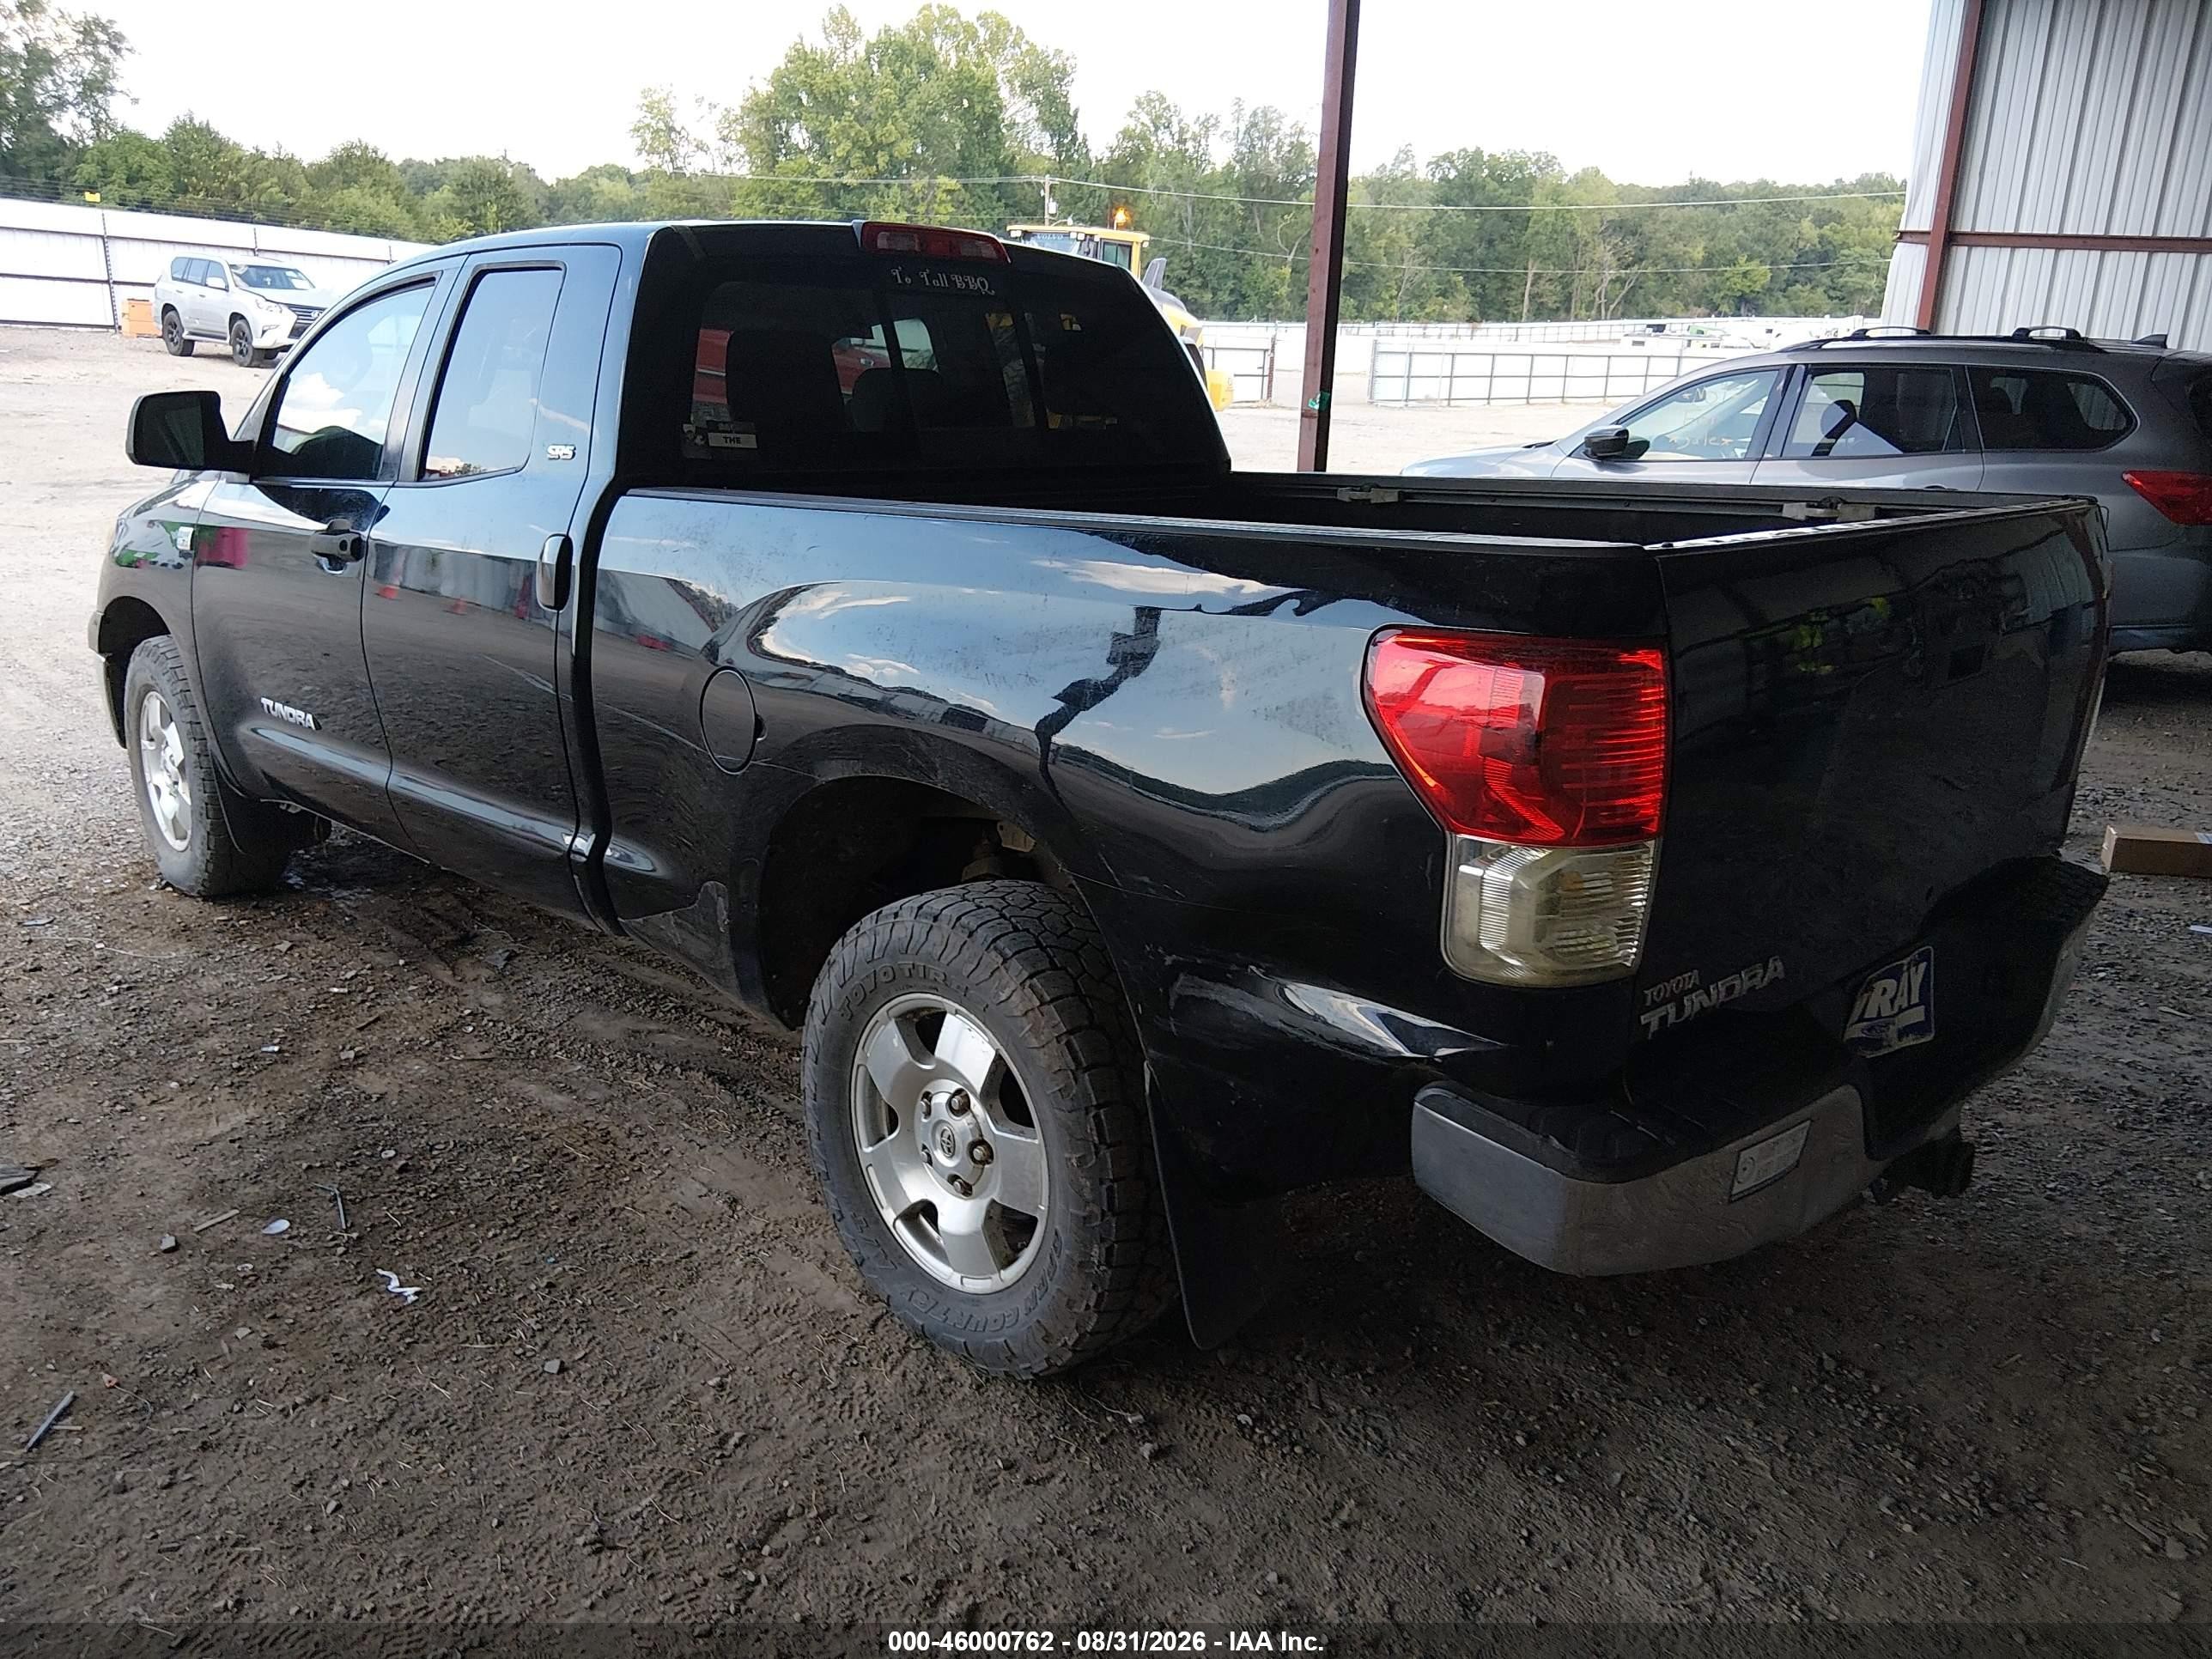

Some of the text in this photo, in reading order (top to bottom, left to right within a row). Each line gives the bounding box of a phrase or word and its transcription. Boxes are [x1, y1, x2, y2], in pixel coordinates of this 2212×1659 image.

[891, 266, 995, 295] To Tall BBQ
[722, 435, 742, 445] THE
[260, 696, 316, 731] TUNDRA
[839, 963, 896, 1021] TOYO
[1640, 955, 1785, 1040] TUNDRA
[1643, 969, 1699, 1006] TOYOTA
